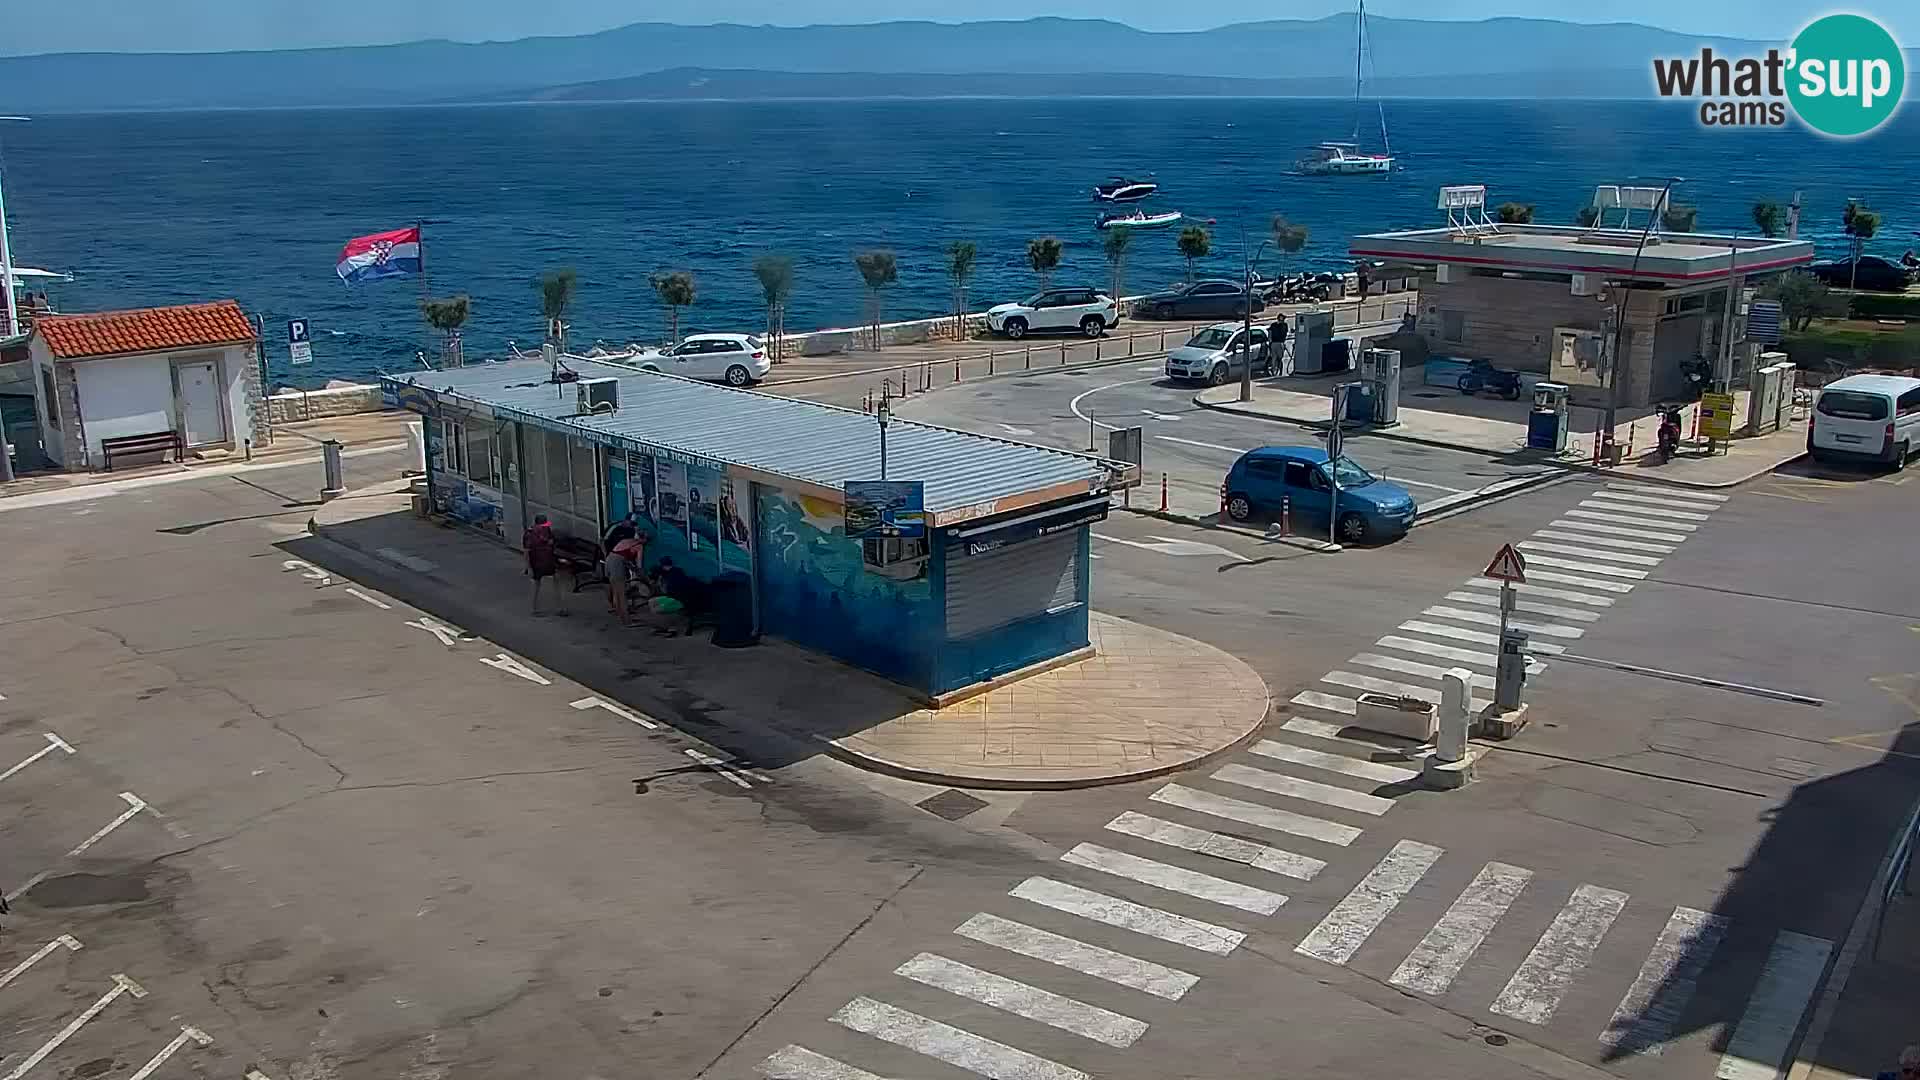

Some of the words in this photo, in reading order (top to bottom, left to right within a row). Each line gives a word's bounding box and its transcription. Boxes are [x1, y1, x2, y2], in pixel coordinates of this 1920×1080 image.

[292, 321, 304, 340] P
[622, 439, 636, 451] BUS
[637, 443, 668, 459] STATION
[671, 451, 696, 466] TICKET
[697, 457, 723, 472] OFFICE
